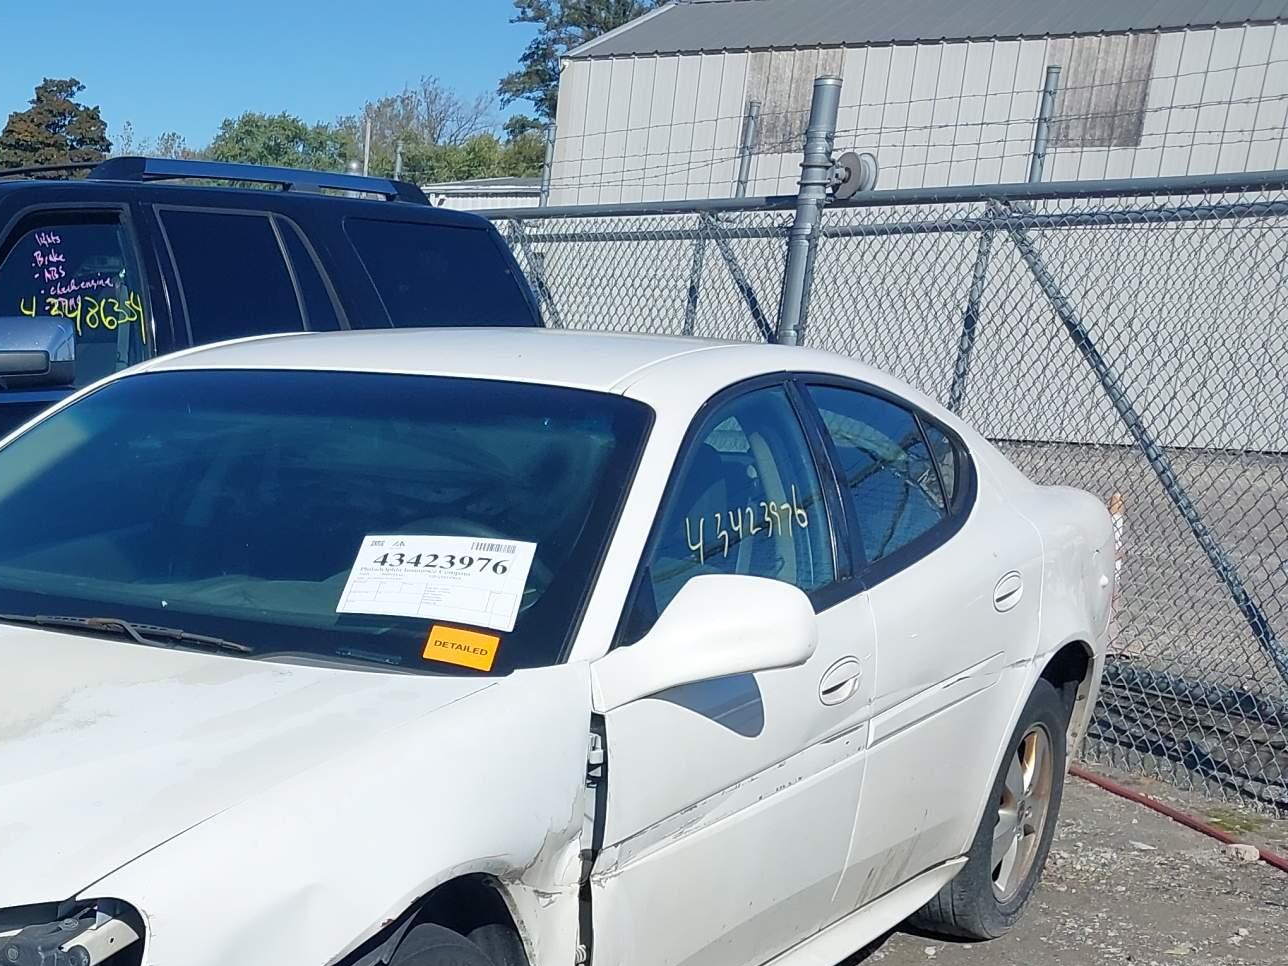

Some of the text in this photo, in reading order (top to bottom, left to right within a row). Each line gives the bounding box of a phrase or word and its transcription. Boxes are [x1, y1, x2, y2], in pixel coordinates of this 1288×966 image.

[44, 265, 66, 282] ABS
[373, 552, 511, 575] 43423976
[433, 639, 488, 657] DETAILED
